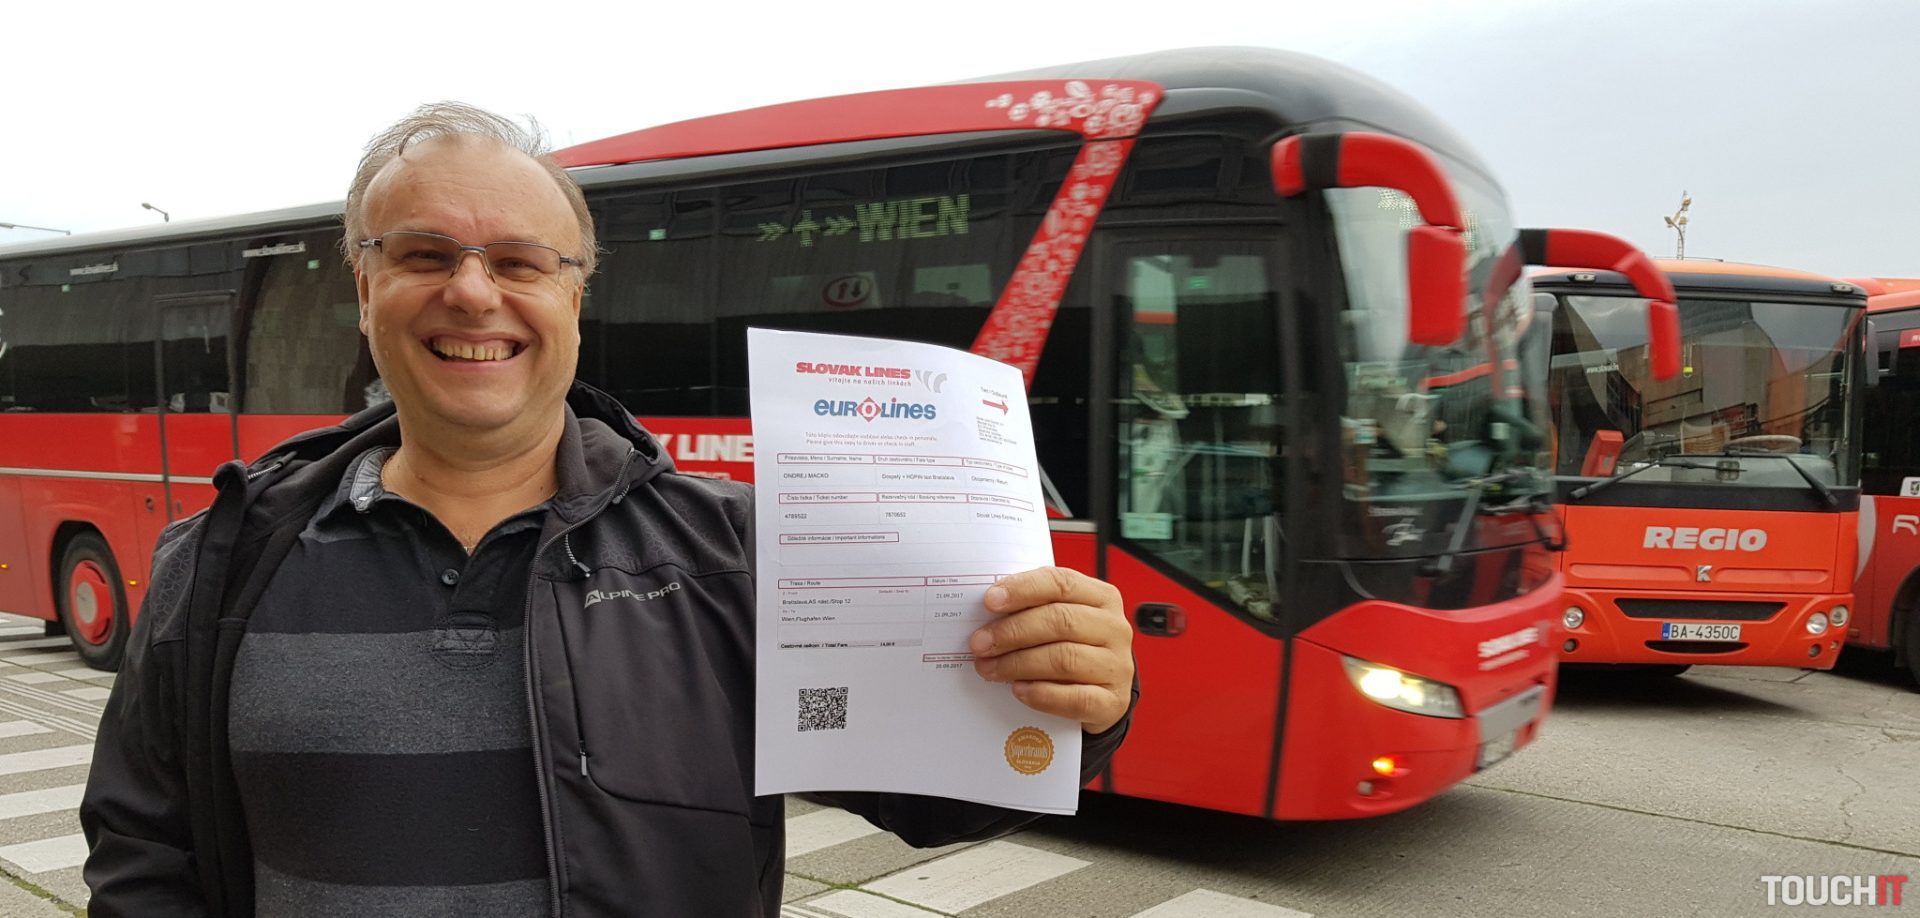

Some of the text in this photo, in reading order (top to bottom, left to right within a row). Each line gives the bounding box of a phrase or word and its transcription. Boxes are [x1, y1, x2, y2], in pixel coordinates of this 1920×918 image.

[855, 194, 970, 242] WIEN
[796, 362, 911, 379] SLOVAK LINES
[828, 377, 851, 386] vitajte
[677, 434, 754, 462] LINE
[1642, 526, 1768, 552] REGIO
[584, 582, 682, 609] ALPINE PRO
[1671, 625, 1739, 640] BA-4350C
